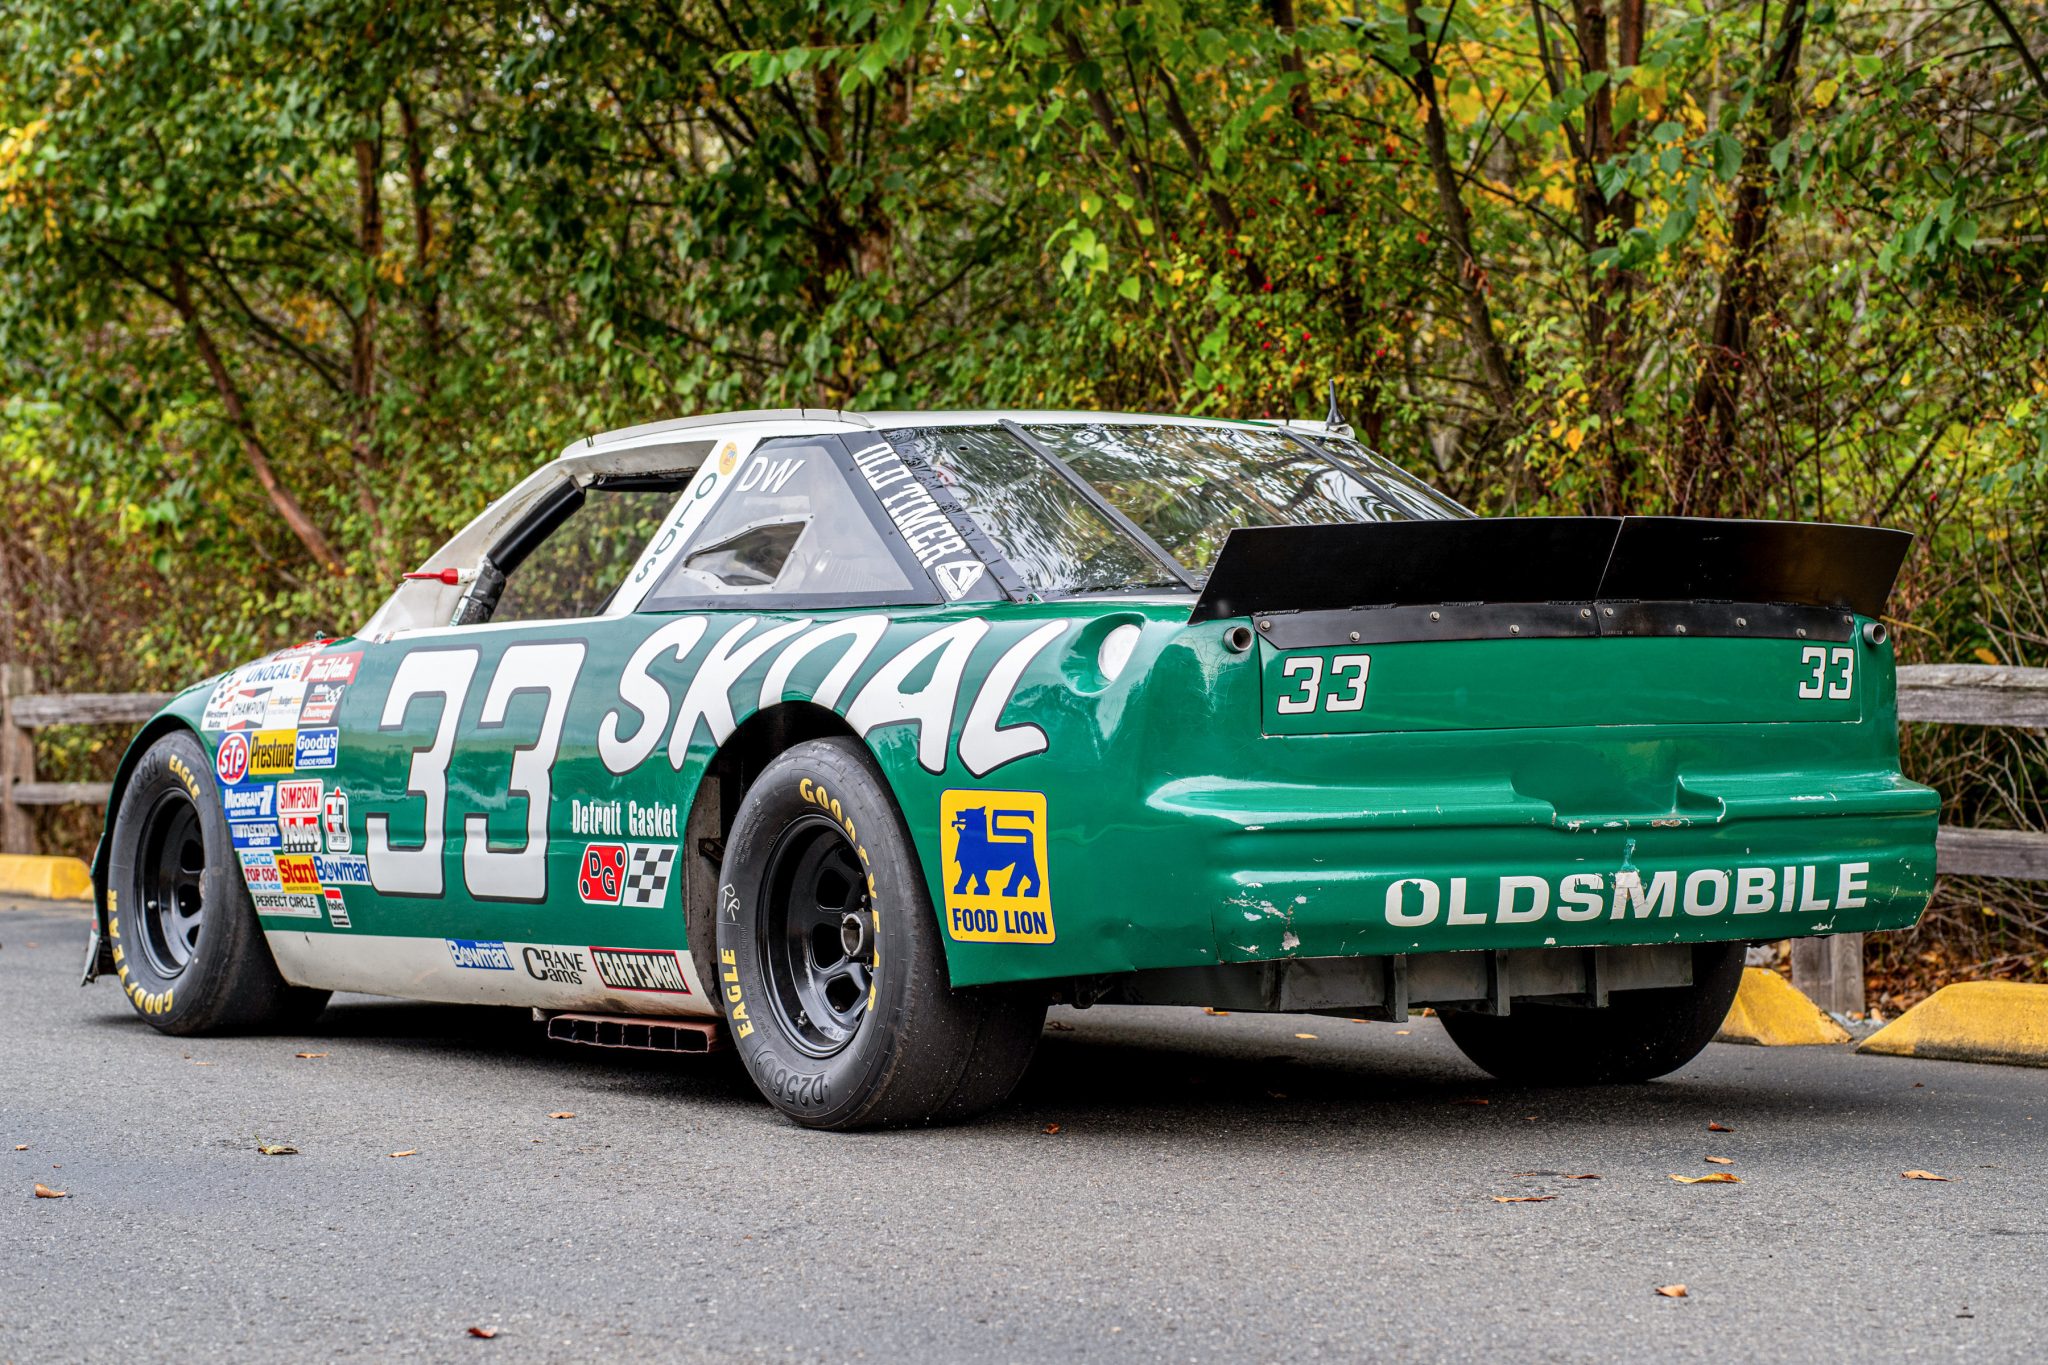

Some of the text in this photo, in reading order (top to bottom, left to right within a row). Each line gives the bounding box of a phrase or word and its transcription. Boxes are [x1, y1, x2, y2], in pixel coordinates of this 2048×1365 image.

[735, 456, 806, 494] DW
[852, 442, 966, 569] OLD TIMER
[246, 663, 292, 683] UNOCAL
[1276, 654, 1372, 715] 33
[1798, 645, 1856, 701] 33
[231, 701, 266, 716] CHAMPION
[597, 614, 1071, 779] SKOAL
[220, 739, 245, 776] STP
[250, 736, 295, 768] Prestone
[297, 733, 337, 754] Goody's
[169, 754, 200, 800] EAGLE
[366, 637, 589, 904] 33
[280, 785, 319, 809] SIMPSON
[280, 816, 322, 852] Holley
[572, 799, 679, 838] Detroit Gasket
[245, 868, 279, 881] TOP COG
[278, 858, 320, 883] Stant
[313, 855, 371, 882] Bowman
[256, 895, 316, 909] PERFECT CIRCLE
[1383, 861, 1871, 927] OLDSMOBILE
[952, 908, 1048, 935] FOOD LION
[446, 940, 514, 968] Bowman
[522, 946, 587, 981] CRANE
[593, 951, 687, 990] CRAFTSMAN
[721, 948, 755, 1039] EAGLE
